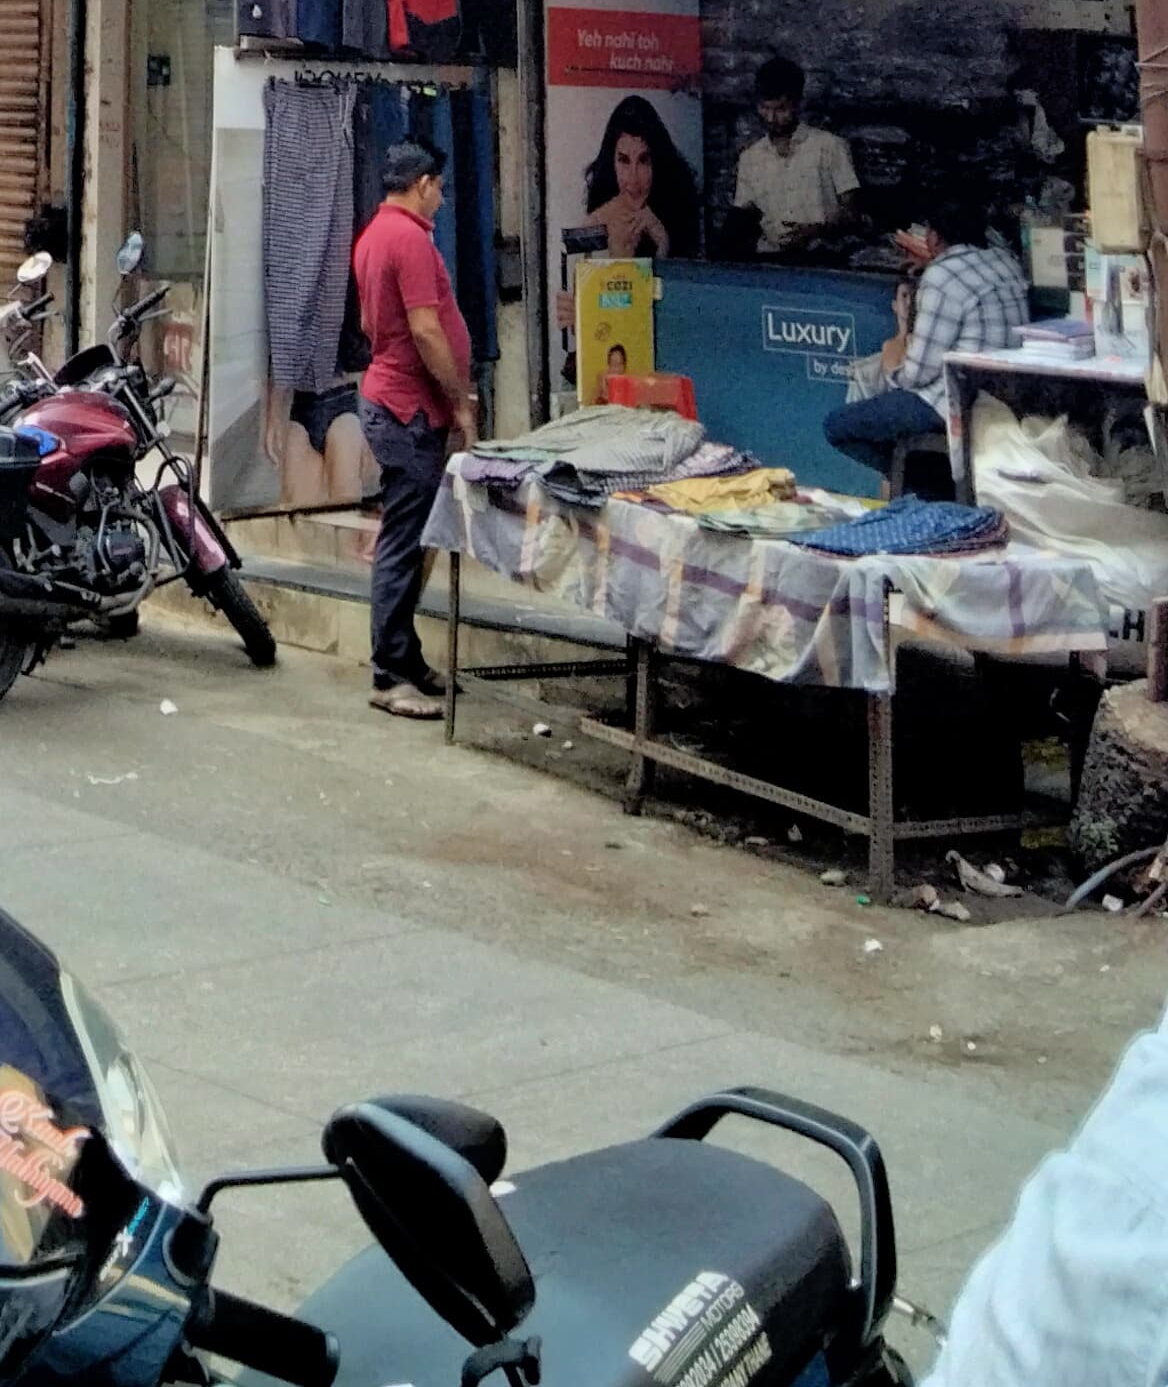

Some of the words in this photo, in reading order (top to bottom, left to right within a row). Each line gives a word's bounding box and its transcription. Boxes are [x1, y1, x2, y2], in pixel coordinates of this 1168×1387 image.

[577, 29, 602, 47] Yeh
[605, 31, 636, 49] nahi
[638, 32, 659, 50] toh
[610, 53, 641, 70] kuch
[643, 55, 674, 71] nahi
[767, 311, 851, 354] Luxury
[813, 359, 828, 377] by
[700, 1279, 745, 1332] MOTORS
